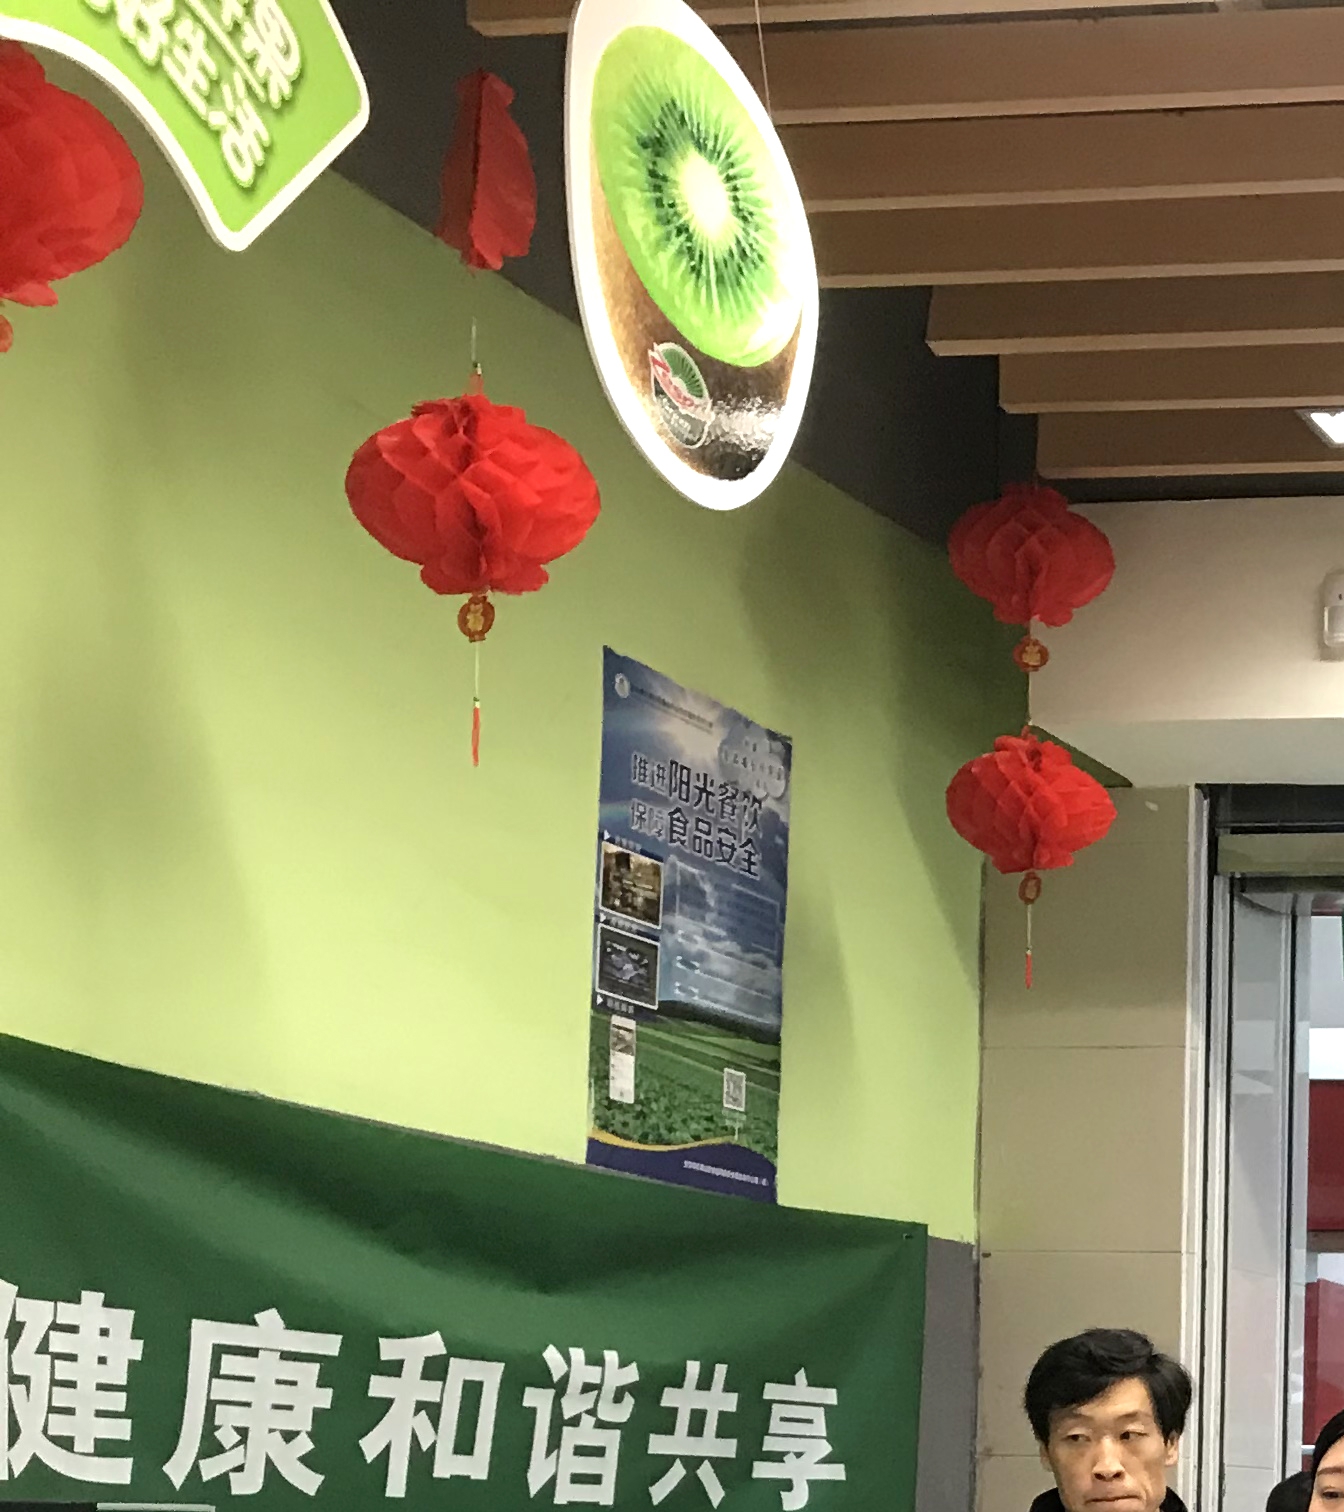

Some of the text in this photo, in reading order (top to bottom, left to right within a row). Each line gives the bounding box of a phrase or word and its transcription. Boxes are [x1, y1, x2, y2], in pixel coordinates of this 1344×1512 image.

[0, 1280, 846, 1512] 健康和谐共享
